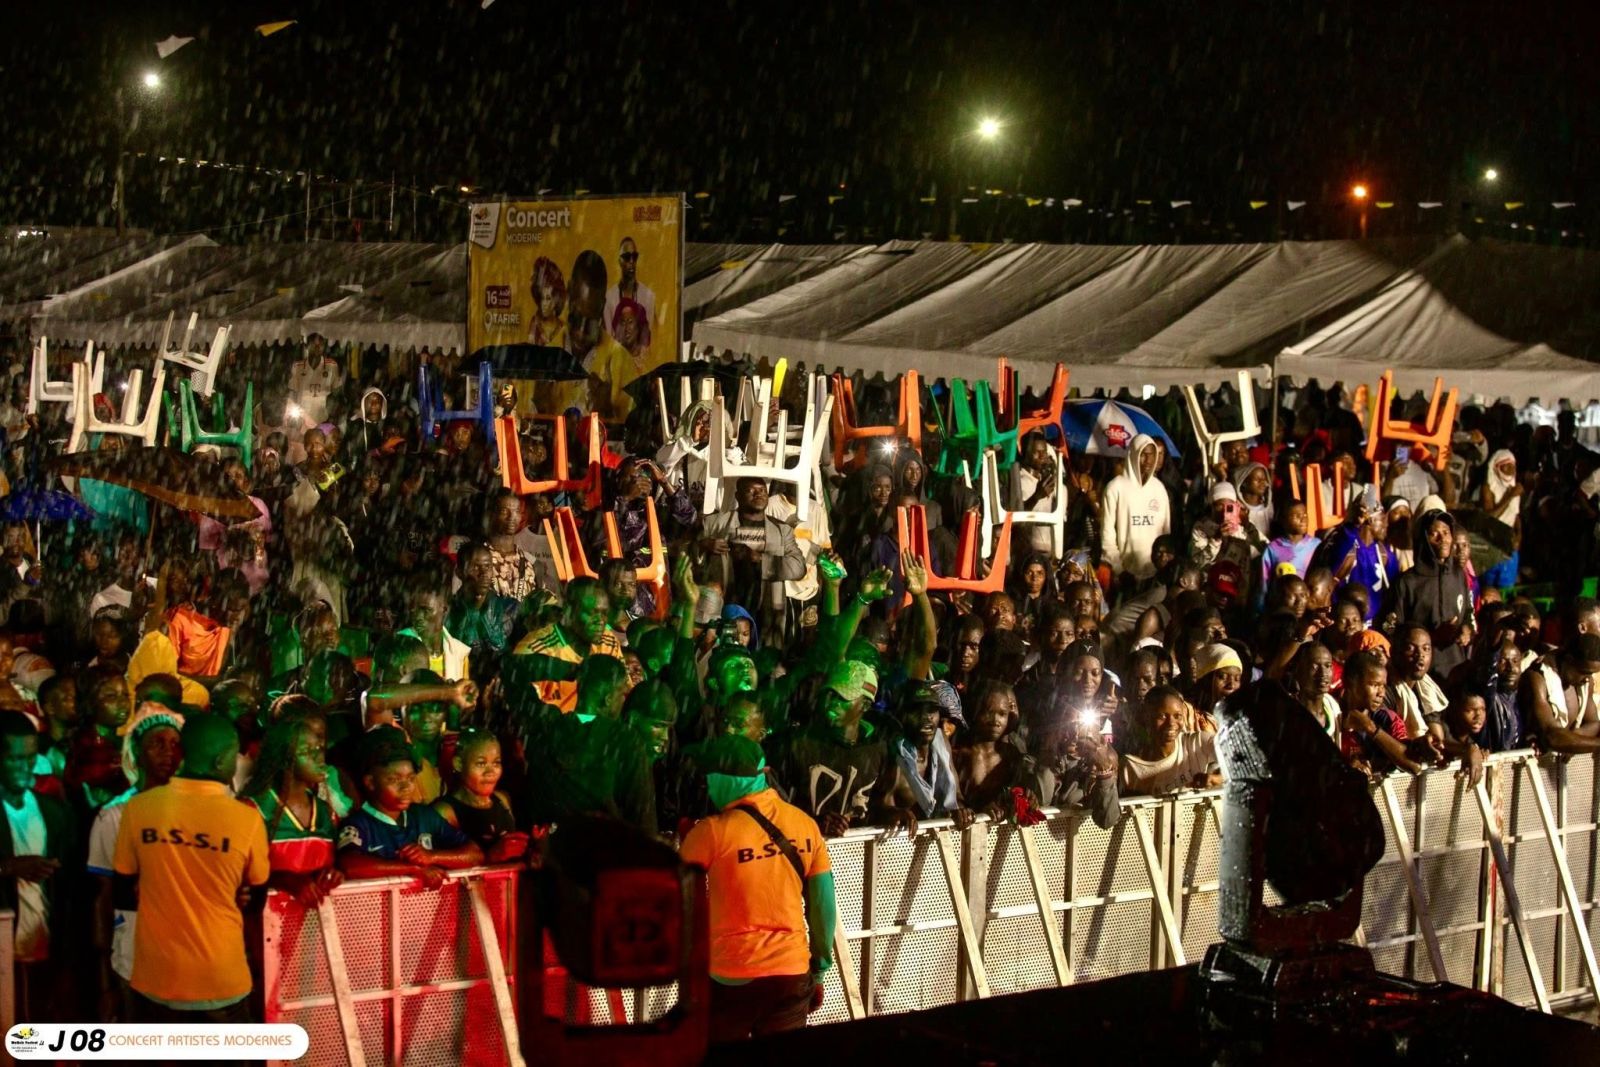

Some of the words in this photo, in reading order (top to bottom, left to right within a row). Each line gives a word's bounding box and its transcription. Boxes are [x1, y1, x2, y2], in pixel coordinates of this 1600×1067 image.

[506, 207, 570, 228] Concert
[506, 233, 543, 242] MODERNE
[486, 290, 497, 305] 16
[1132, 515, 1154, 526] EA
